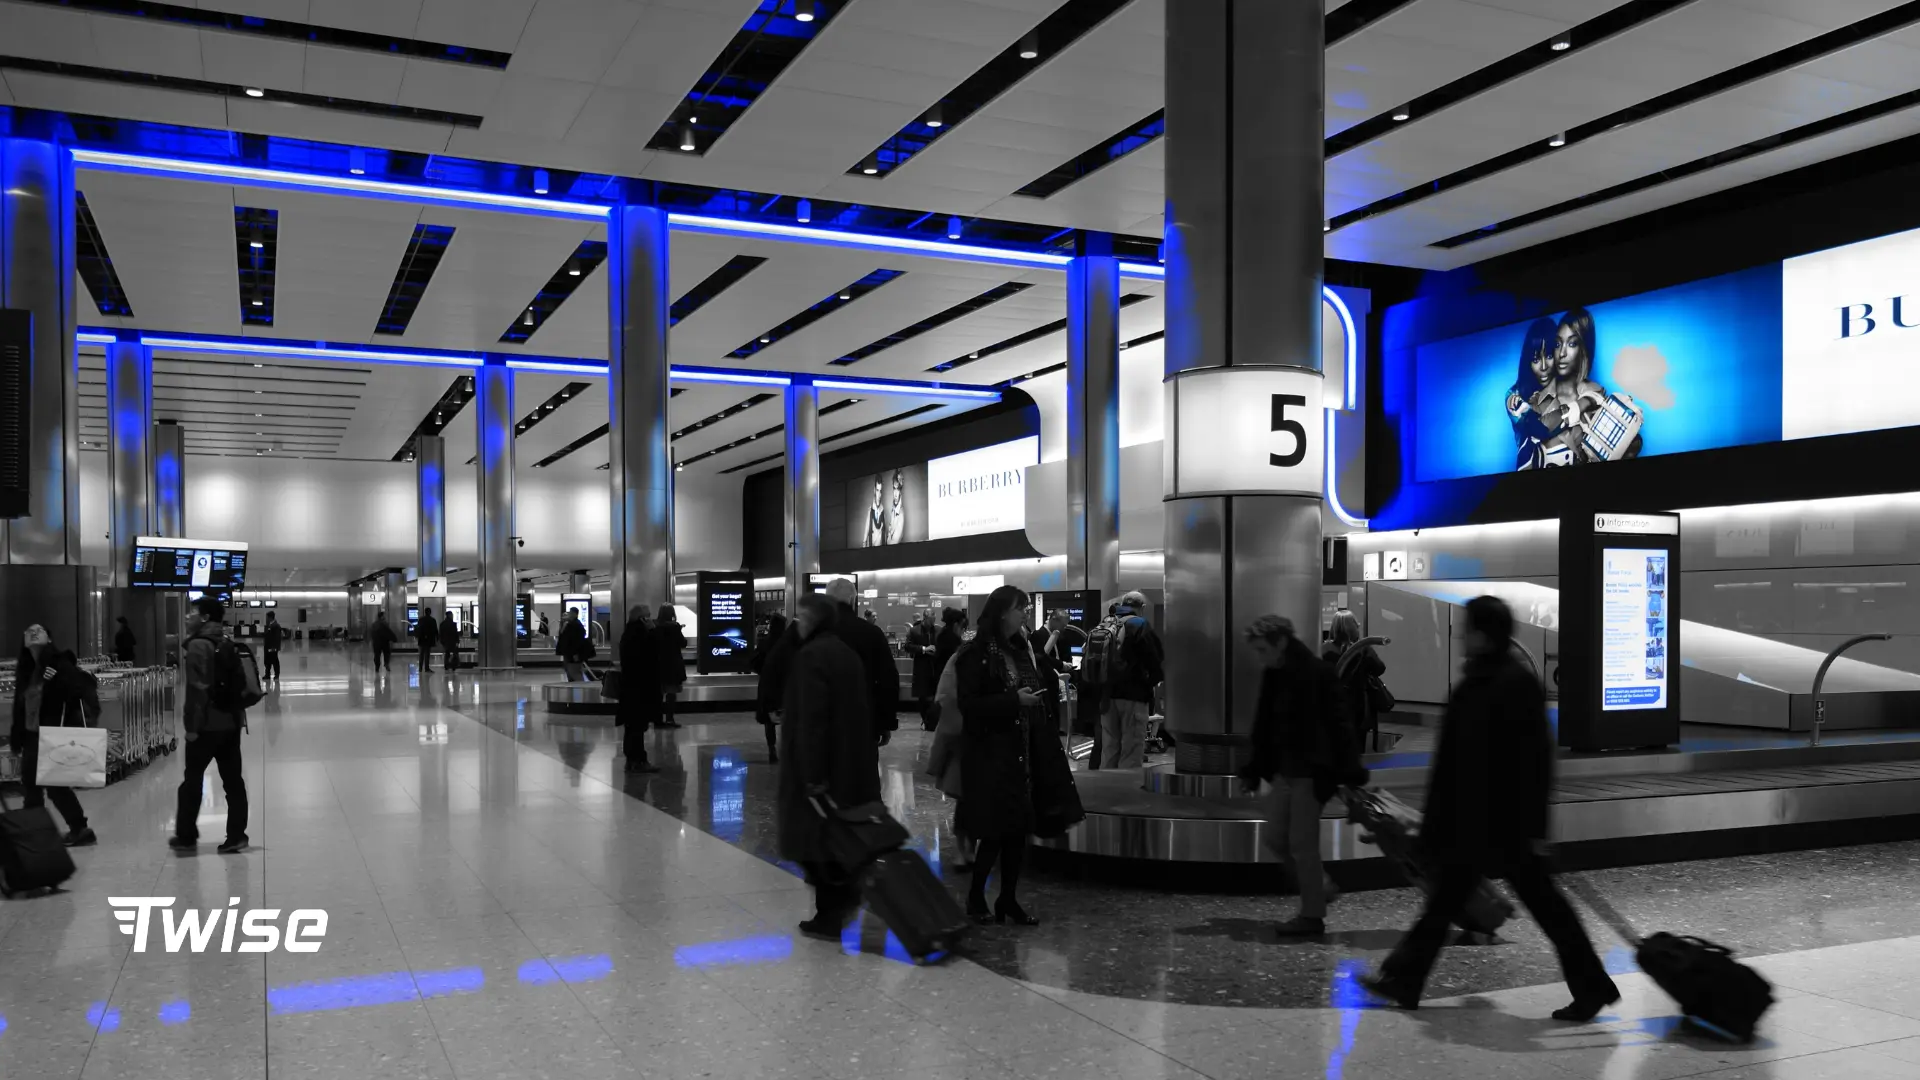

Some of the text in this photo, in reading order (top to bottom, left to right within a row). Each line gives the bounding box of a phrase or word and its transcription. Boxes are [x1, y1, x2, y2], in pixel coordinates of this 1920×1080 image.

[1269, 393, 1307, 467] 5
[938, 468, 1021, 498] BURBERRY
[430, 580, 438, 592] 7
[369, 593, 376, 602] 9
